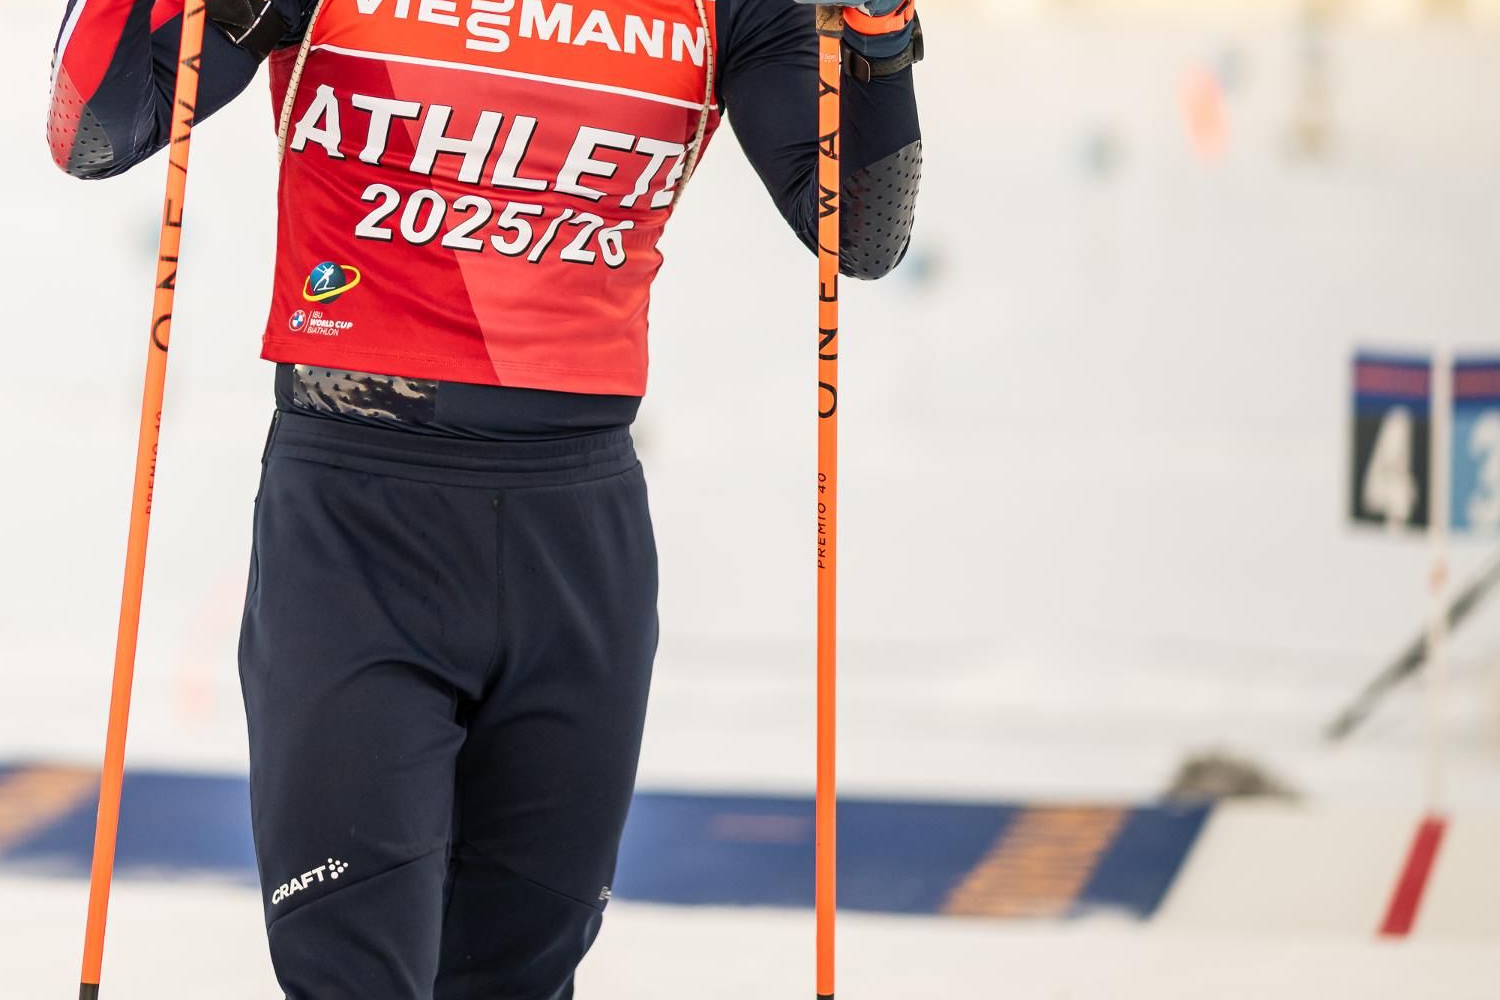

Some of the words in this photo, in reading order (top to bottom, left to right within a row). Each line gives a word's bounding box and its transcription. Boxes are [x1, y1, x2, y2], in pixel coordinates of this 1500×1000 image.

[290, 83, 697, 211] ATHLETE
[354, 182, 635, 269] 2025/26
[307, 326, 339, 336] BIATHLON
[310, 319, 334, 327] WORLD
[335, 320, 353, 329] CUP
[312, 310, 323, 318] IBU
[817, 472, 827, 494] 40
[1362, 405, 1420, 524] 4
[817, 502, 827, 569] PREMIO
[272, 865, 327, 904] CRAFT
